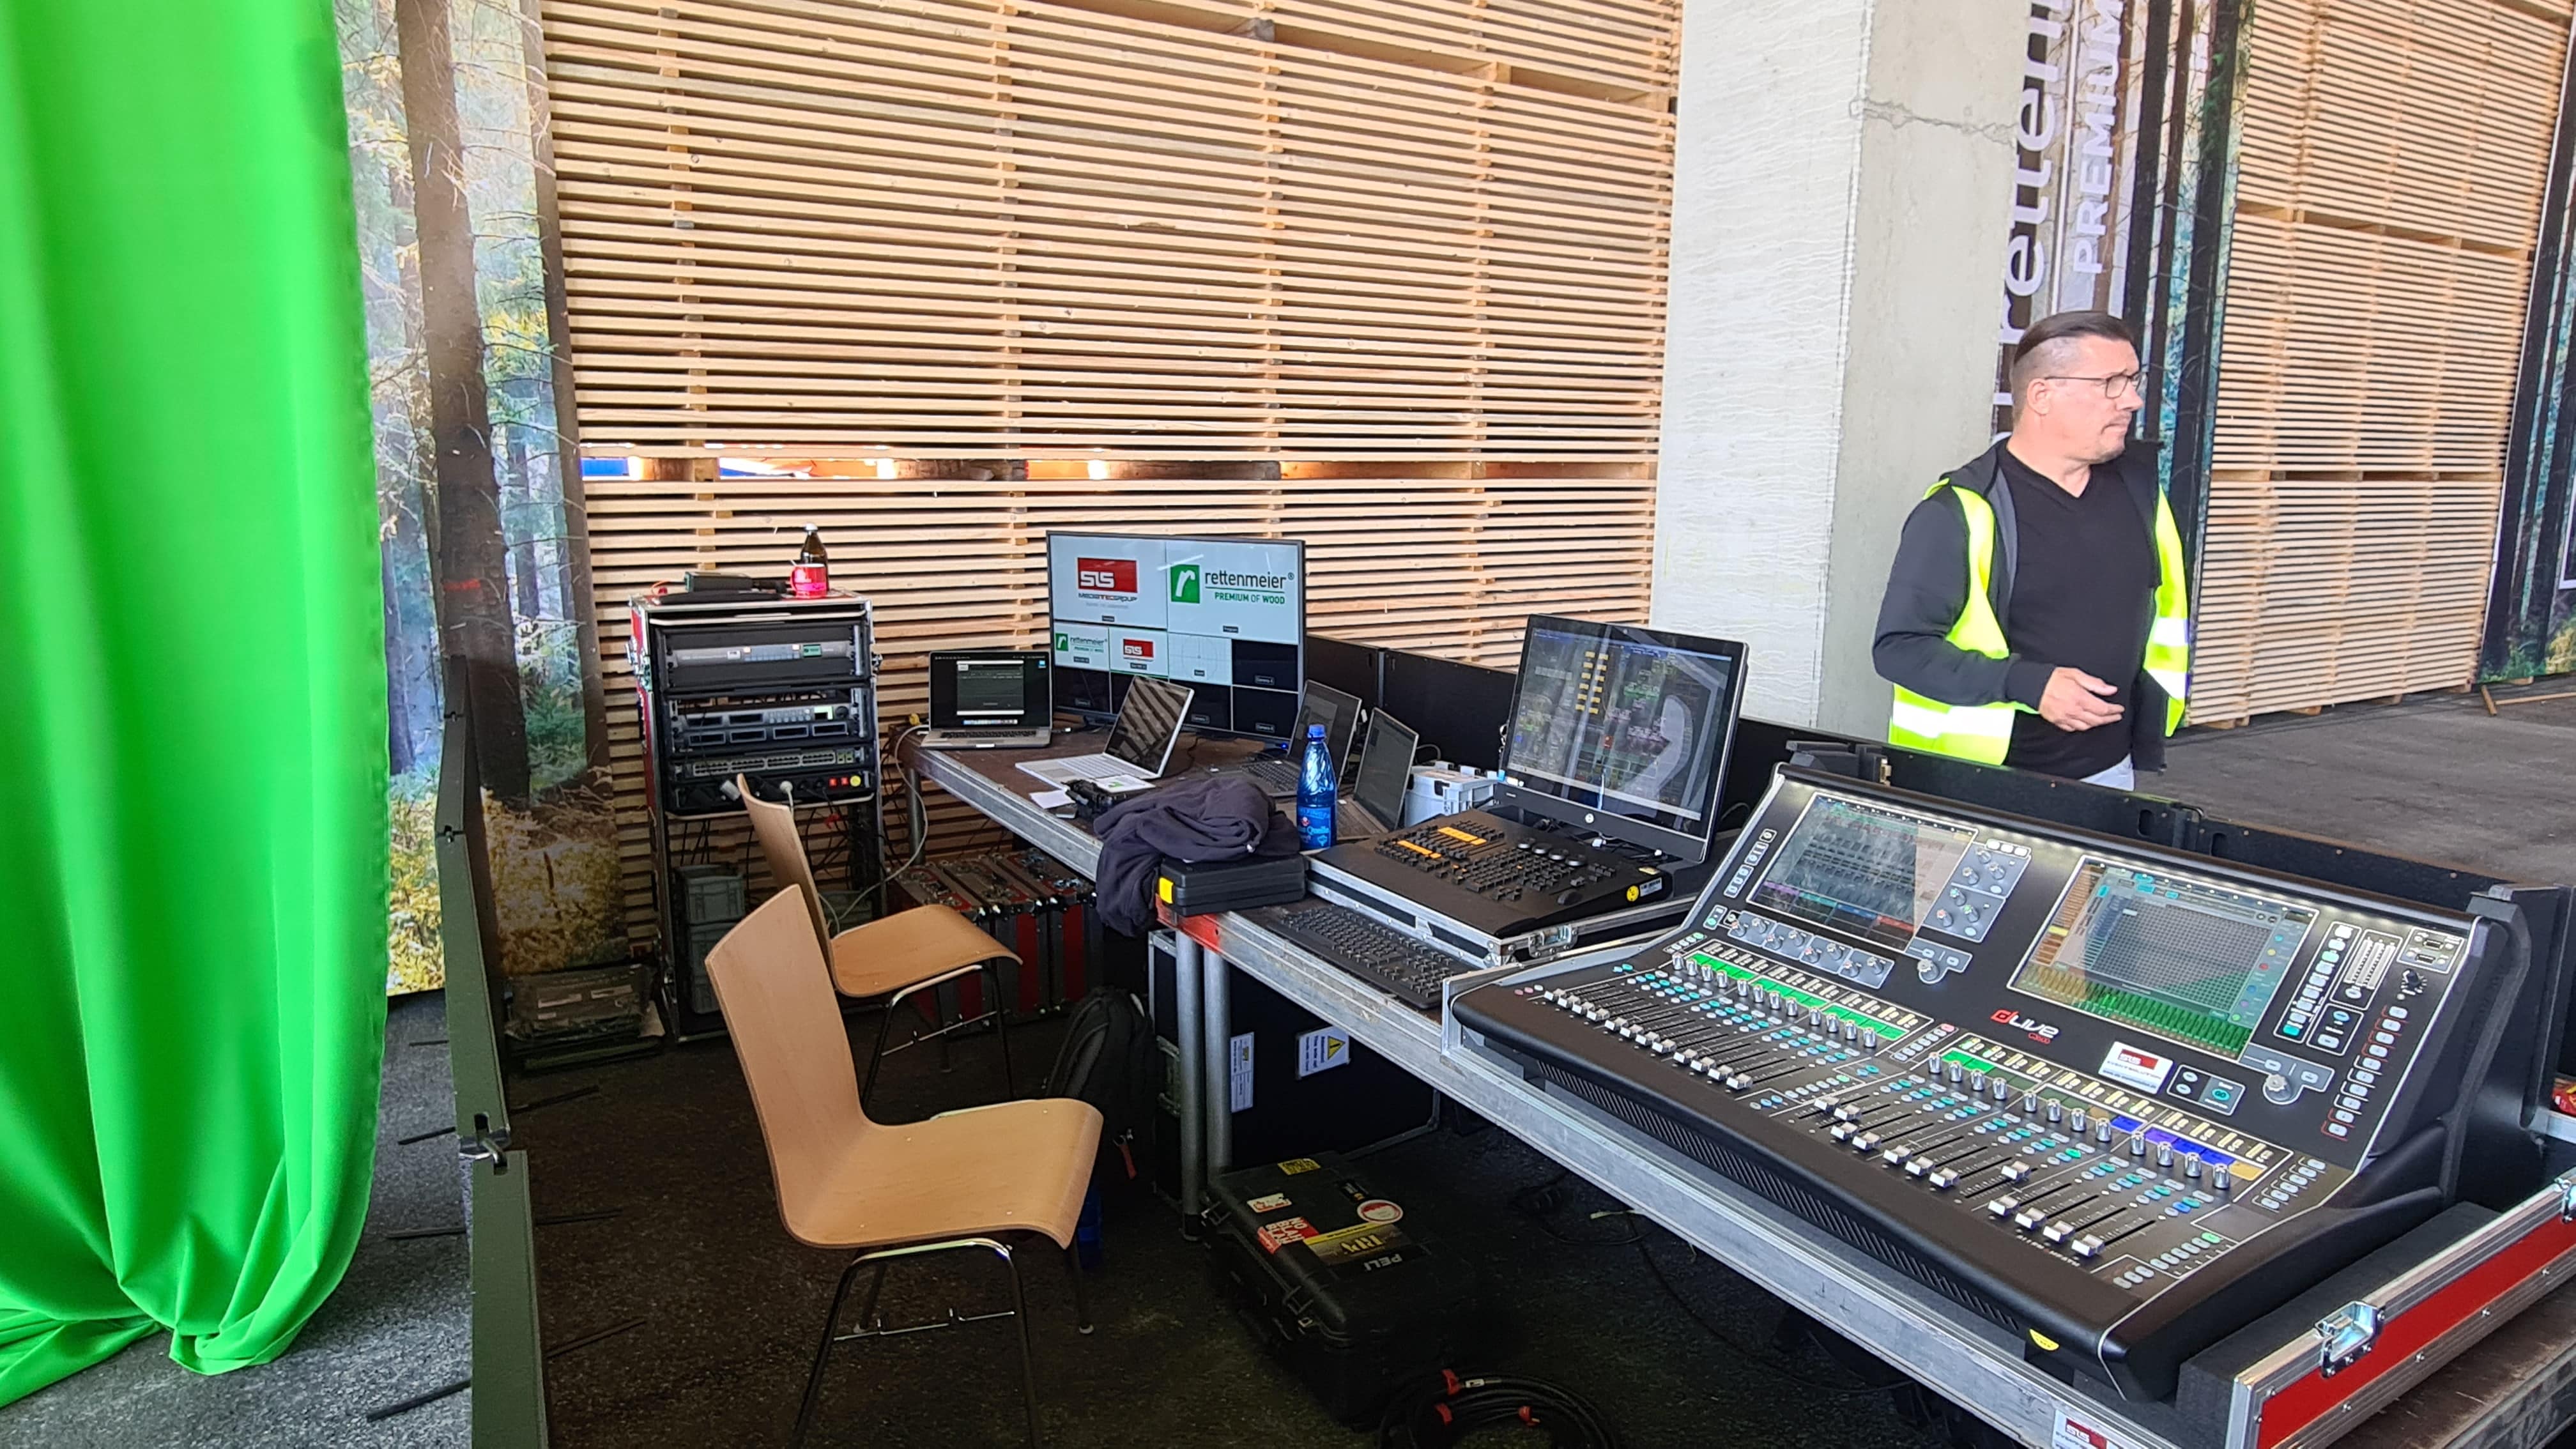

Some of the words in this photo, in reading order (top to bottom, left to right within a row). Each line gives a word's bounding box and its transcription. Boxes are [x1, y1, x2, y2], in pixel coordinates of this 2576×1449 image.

[2074, 0, 2124, 274] PREMIUM
[1998, 0, 2064, 345] retten
[1205, 571, 1286, 588] rettenmeier
[1215, 592, 1249, 602] PREMIUM
[1262, 595, 1285, 604] WOOD
[1364, 1254, 1402, 1271] PELI
